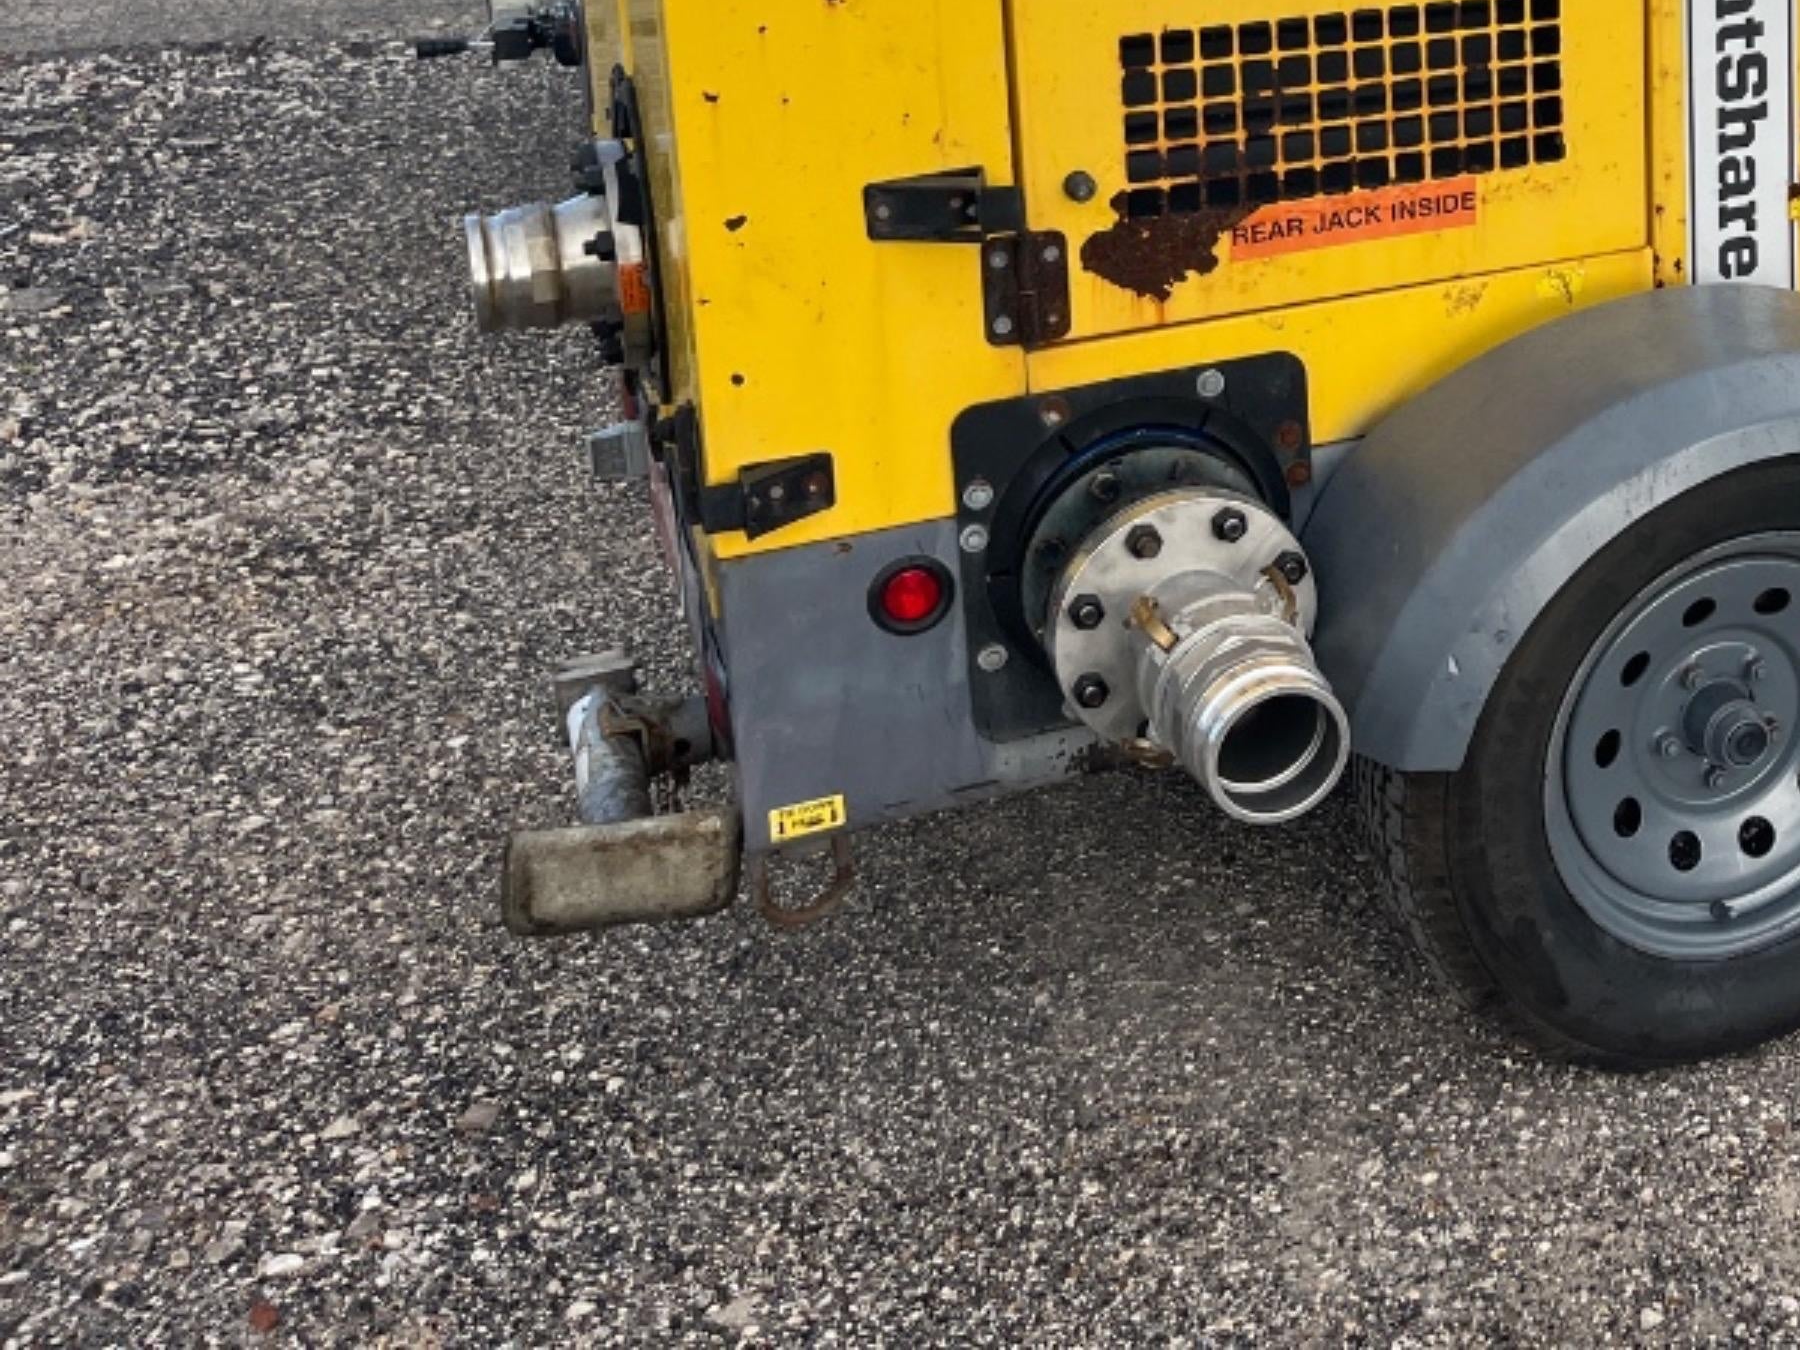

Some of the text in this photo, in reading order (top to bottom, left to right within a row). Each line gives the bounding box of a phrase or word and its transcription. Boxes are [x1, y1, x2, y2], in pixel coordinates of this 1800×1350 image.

[1232, 191, 1476, 246] REAR JACK INSIDE
